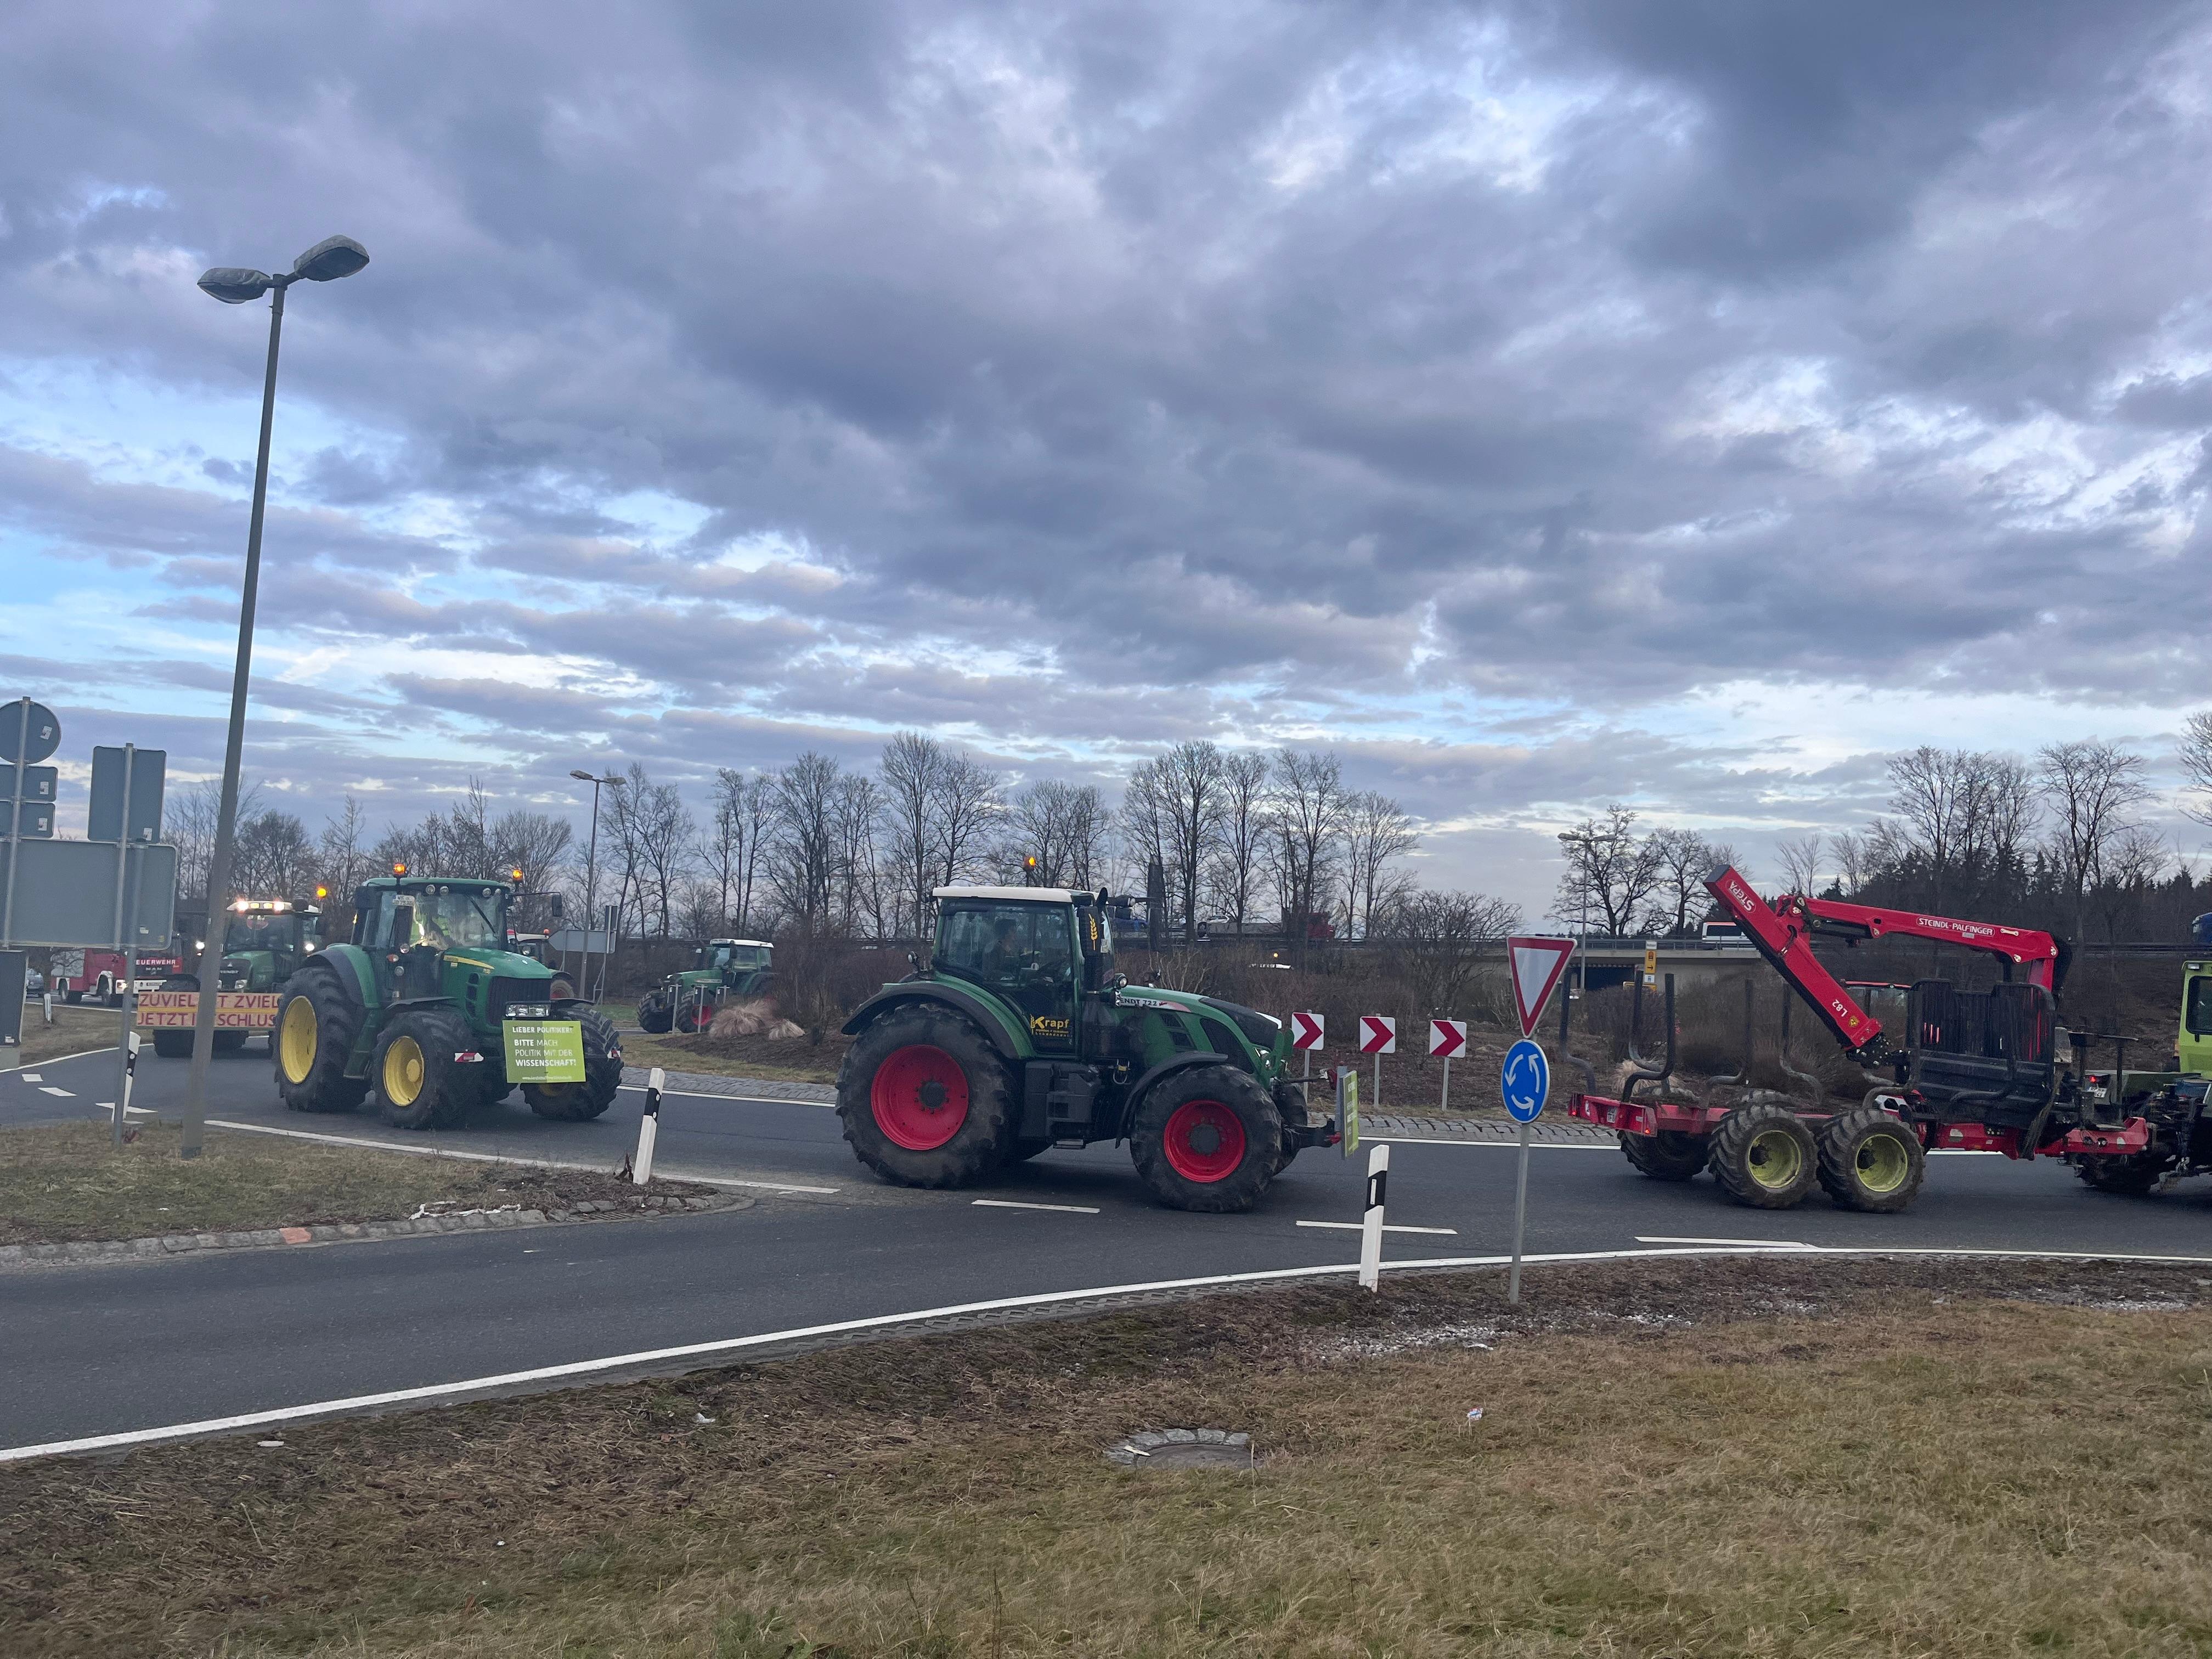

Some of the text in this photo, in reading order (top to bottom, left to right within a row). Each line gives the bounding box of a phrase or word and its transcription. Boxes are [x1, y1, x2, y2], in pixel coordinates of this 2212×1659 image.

[1729, 881, 1754, 911] STEPA
[1919, 918, 1993, 935] STEINDL-PALFINGER
[139, 994, 196, 1007] ZUVIEL
[1832, 998, 1848, 1017] L82
[138, 1012, 187, 1026] JETZT
[217, 1013, 275, 1027] SCHLUS
[1031, 1016, 1070, 1030] Krapf
[515, 1059, 577, 1067] WISSENSCHAFT!
